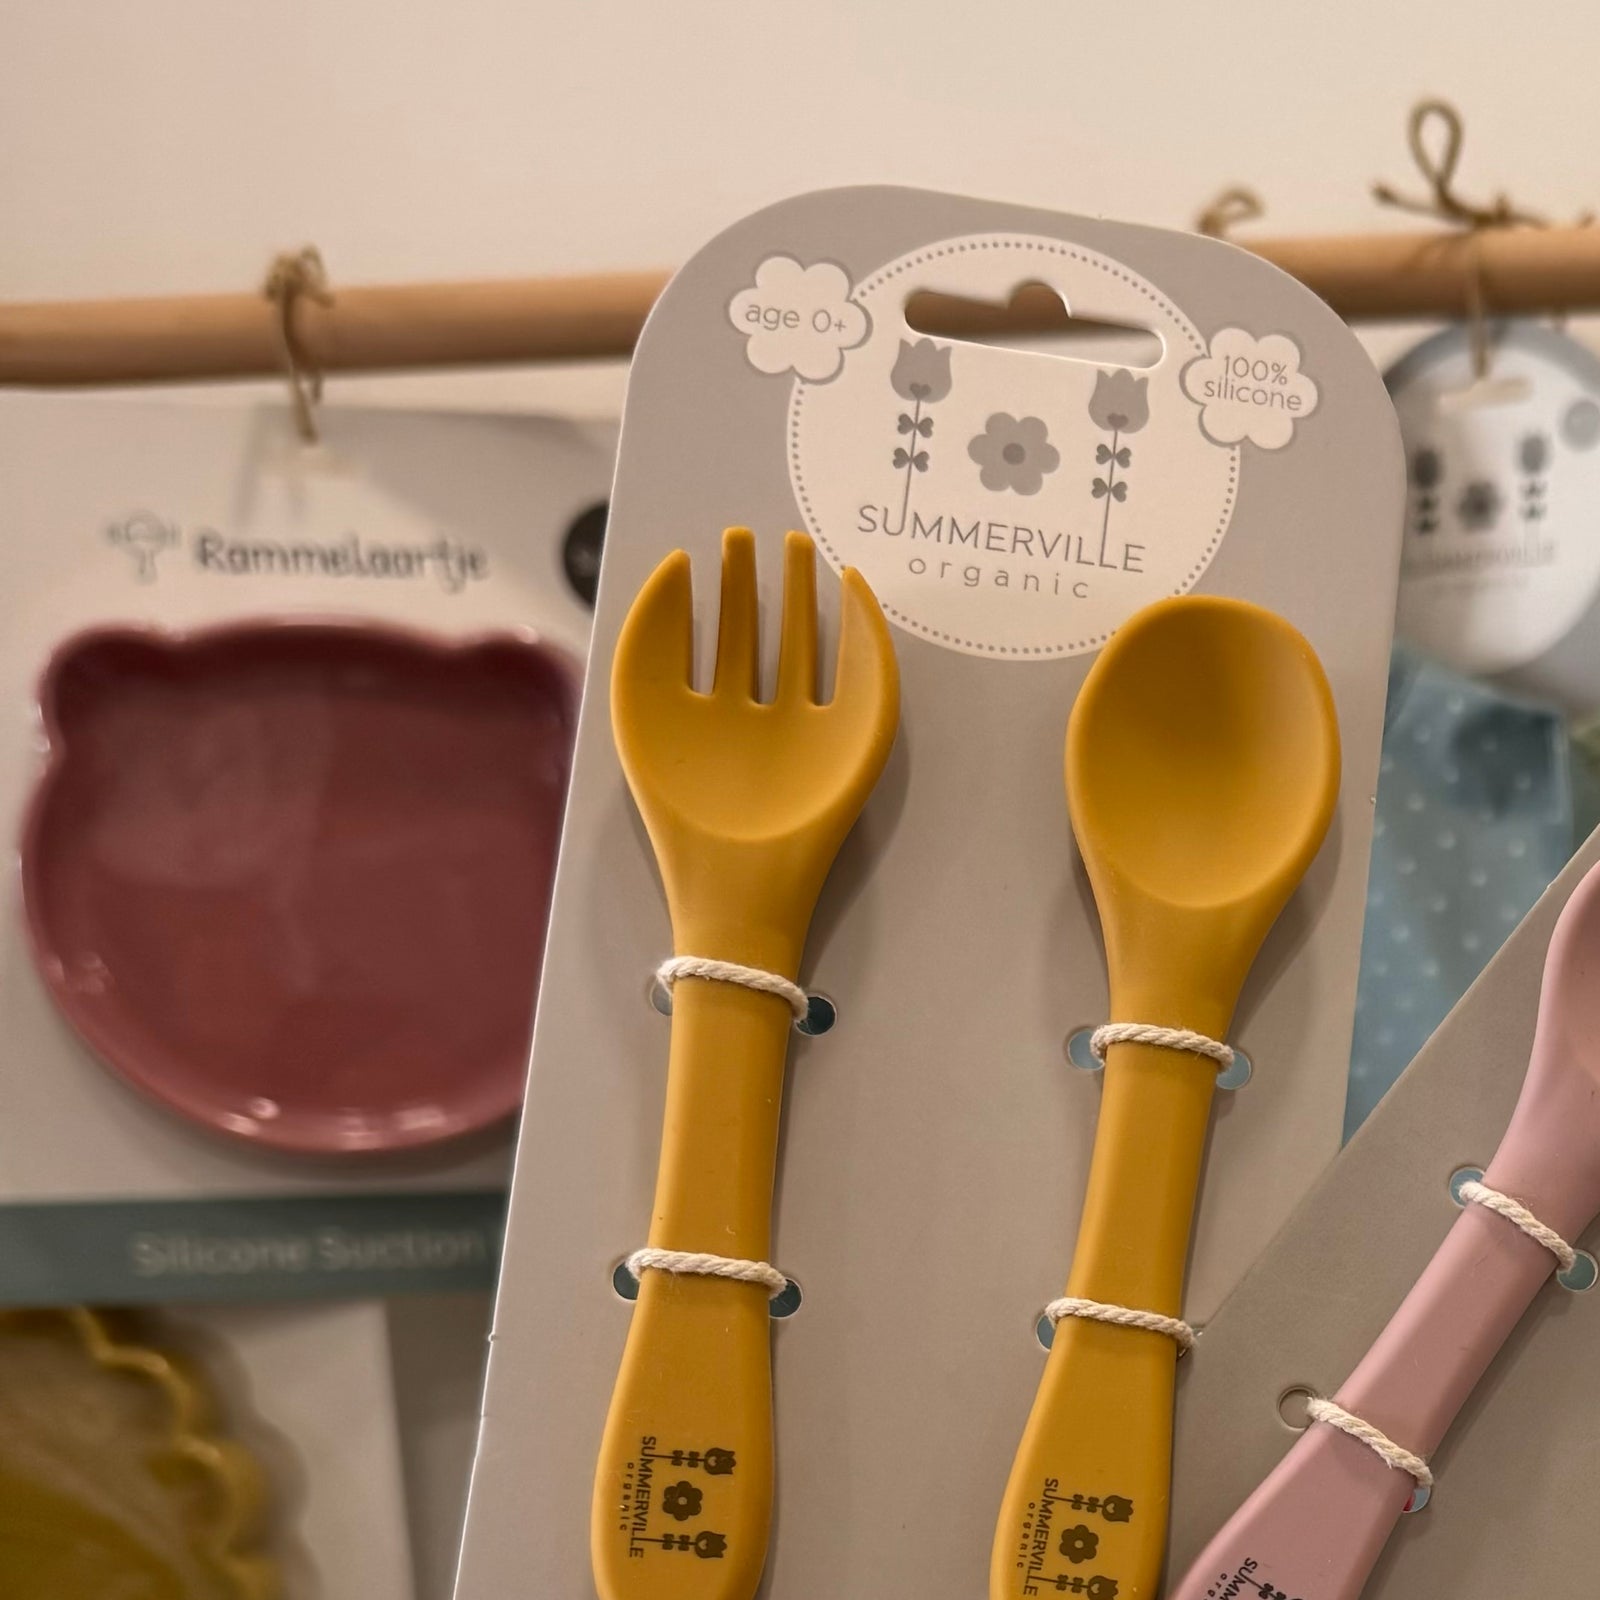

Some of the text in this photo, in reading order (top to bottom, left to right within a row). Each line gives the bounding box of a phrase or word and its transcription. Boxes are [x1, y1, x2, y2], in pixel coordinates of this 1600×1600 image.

[744, 302, 848, 336] age 0+
[1202, 375, 1304, 413] silicone
[1222, 353, 1290, 387] 100%
[857, 503, 1147, 575] SUMMERVILLE
[908, 555, 1091, 600] organic
[619, 1462, 634, 1531] organic
[629, 1436, 656, 1558] SUMMERVILLE
[1017, 1502, 1035, 1568] organic
[1024, 1478, 1058, 1596] SUMMERVILLE
